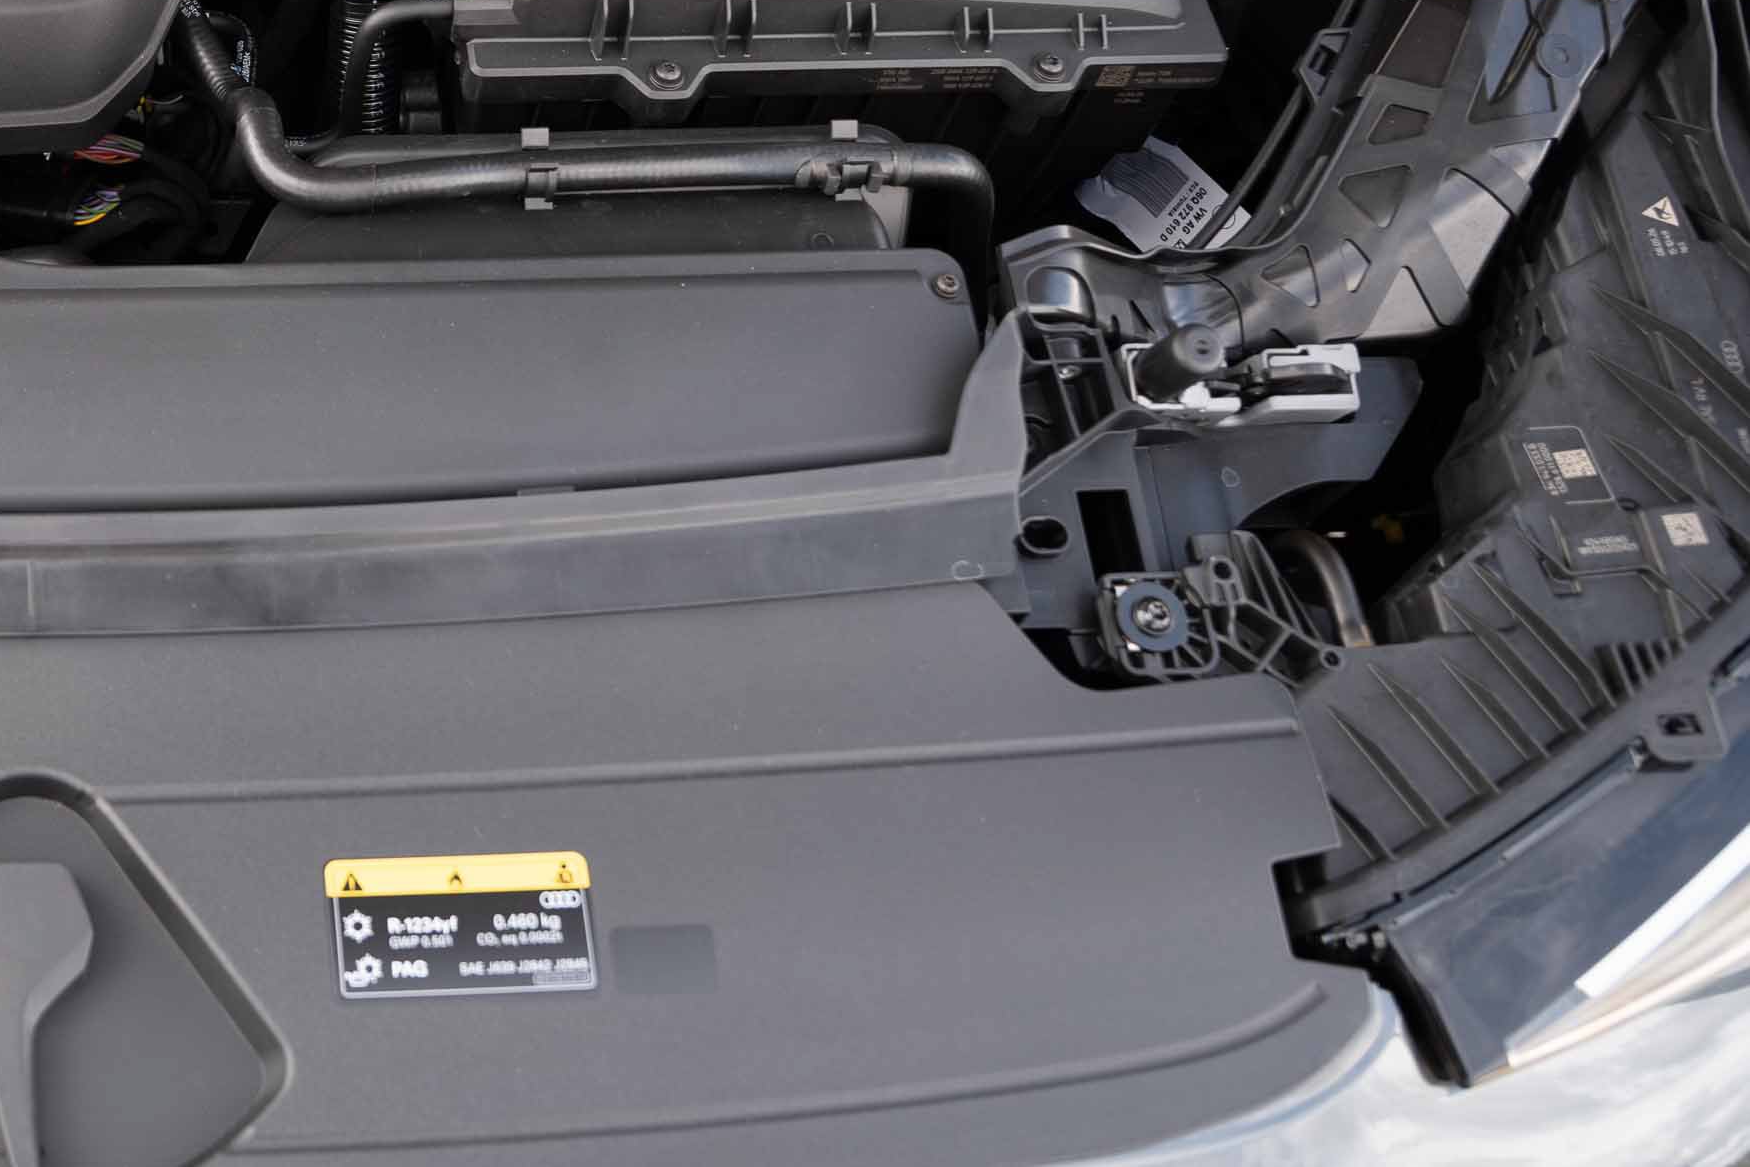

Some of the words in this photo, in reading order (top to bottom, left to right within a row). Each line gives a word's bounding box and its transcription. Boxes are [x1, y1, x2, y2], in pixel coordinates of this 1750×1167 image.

[1177, 204, 1194, 220] 972
[1193, 208, 1208, 223] VW
[1165, 219, 1180, 235] 610
[1182, 220, 1195, 234] AG
[540, 912, 562, 932] kg
[391, 960, 429, 978] PAG
